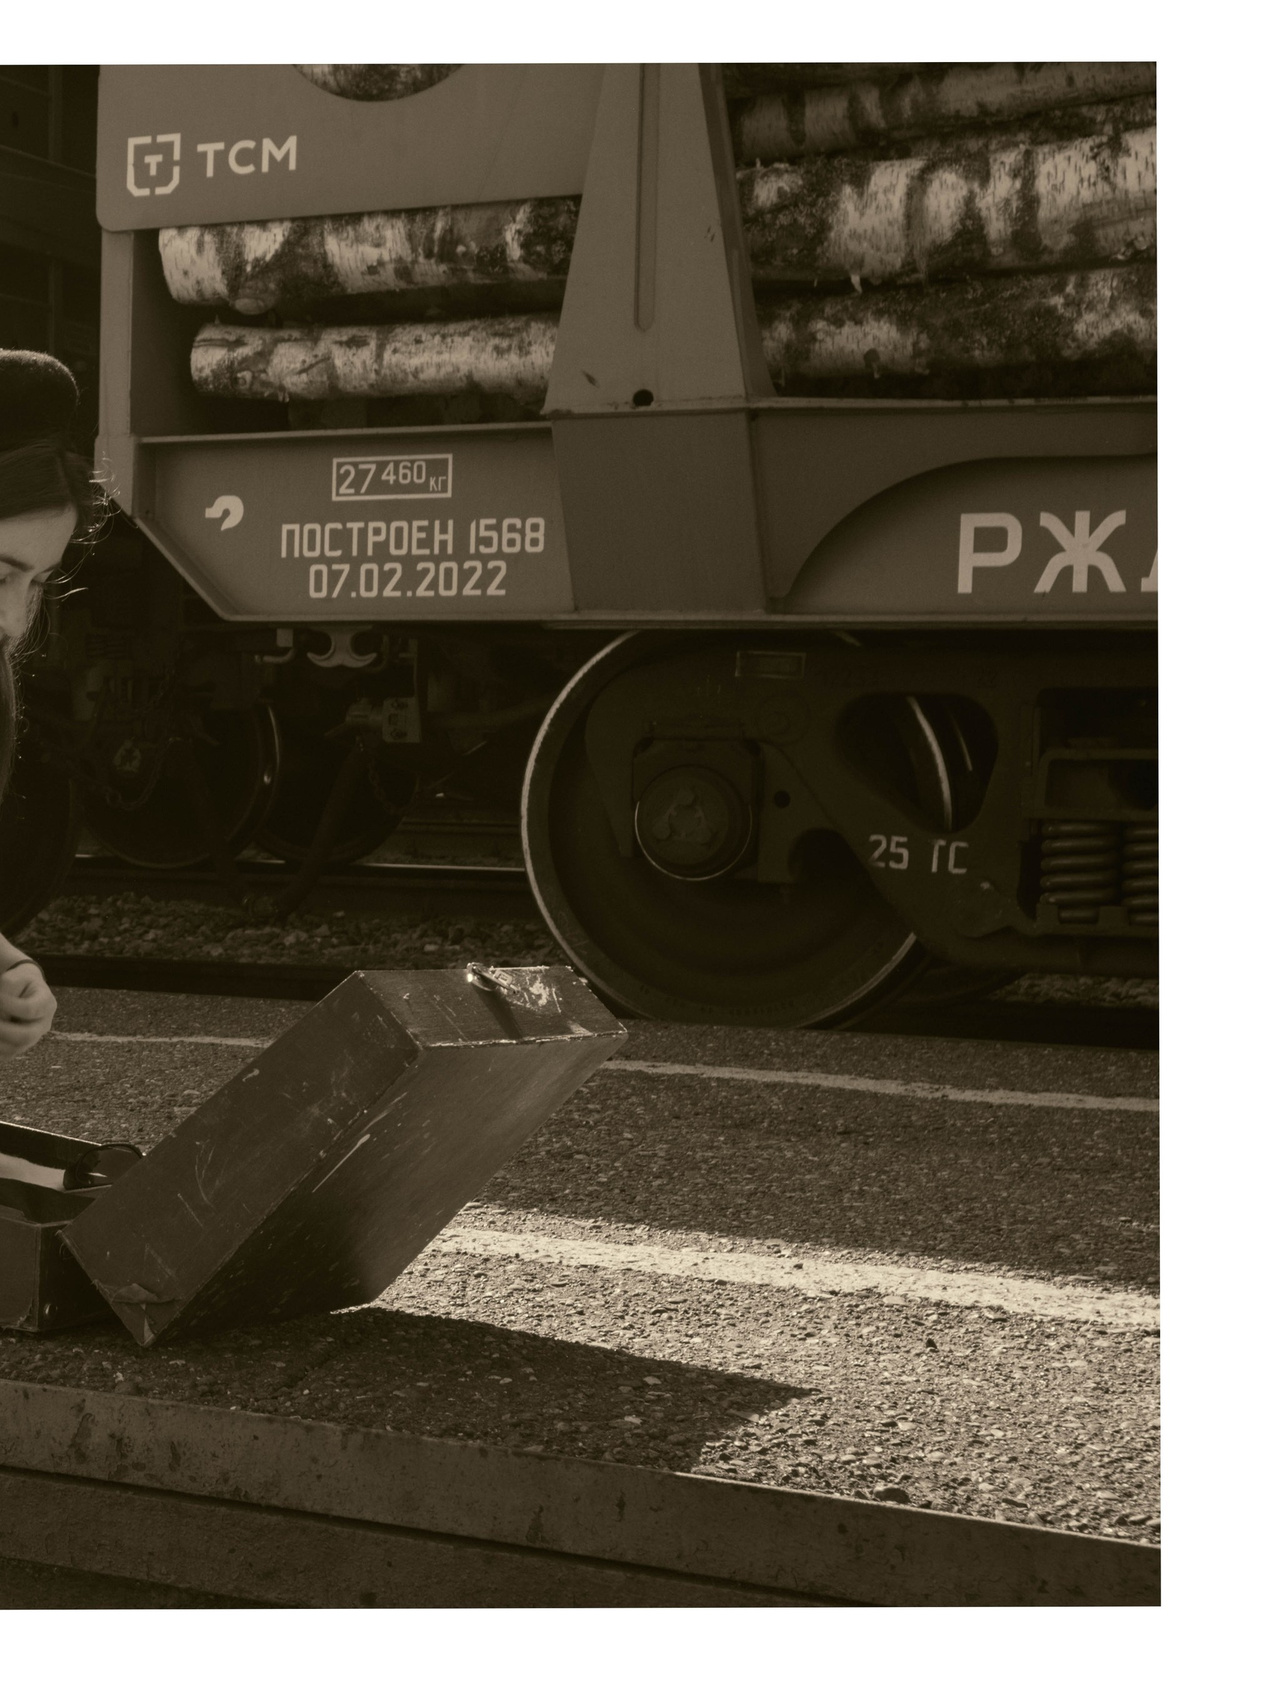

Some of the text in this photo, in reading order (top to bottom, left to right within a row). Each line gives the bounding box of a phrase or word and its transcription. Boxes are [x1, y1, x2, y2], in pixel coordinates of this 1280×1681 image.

[196, 135, 299, 178] ТСМ
[280, 517, 545, 558] ПОСТРОЕН 1568
[957, 509, 1157, 594] РЖ
[308, 560, 508, 600] 07.02.2022
[869, 834, 968, 875] 25 ТС
